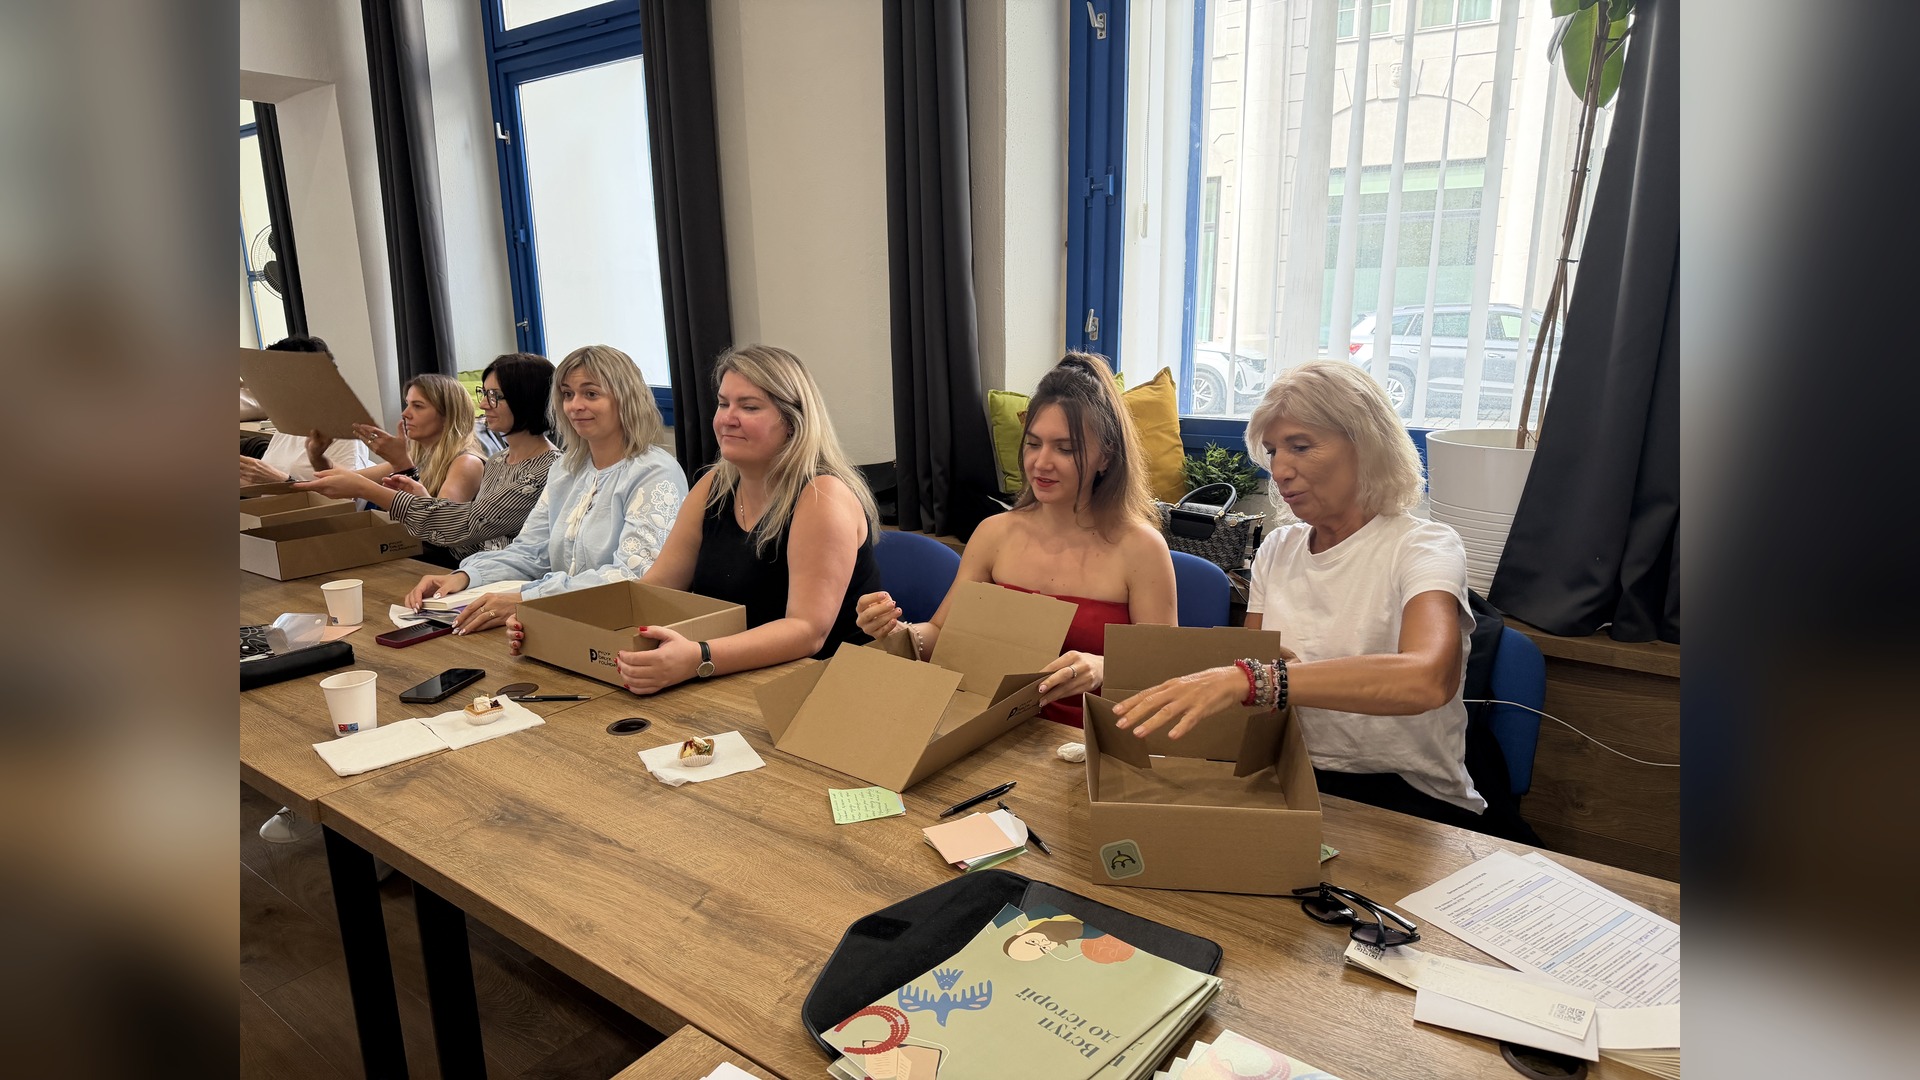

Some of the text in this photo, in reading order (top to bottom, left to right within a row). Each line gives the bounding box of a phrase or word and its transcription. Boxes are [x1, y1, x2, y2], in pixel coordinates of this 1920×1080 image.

[1015, 987, 1121, 1044] до історії
[1038, 1017, 1100, 1059] Вступ
